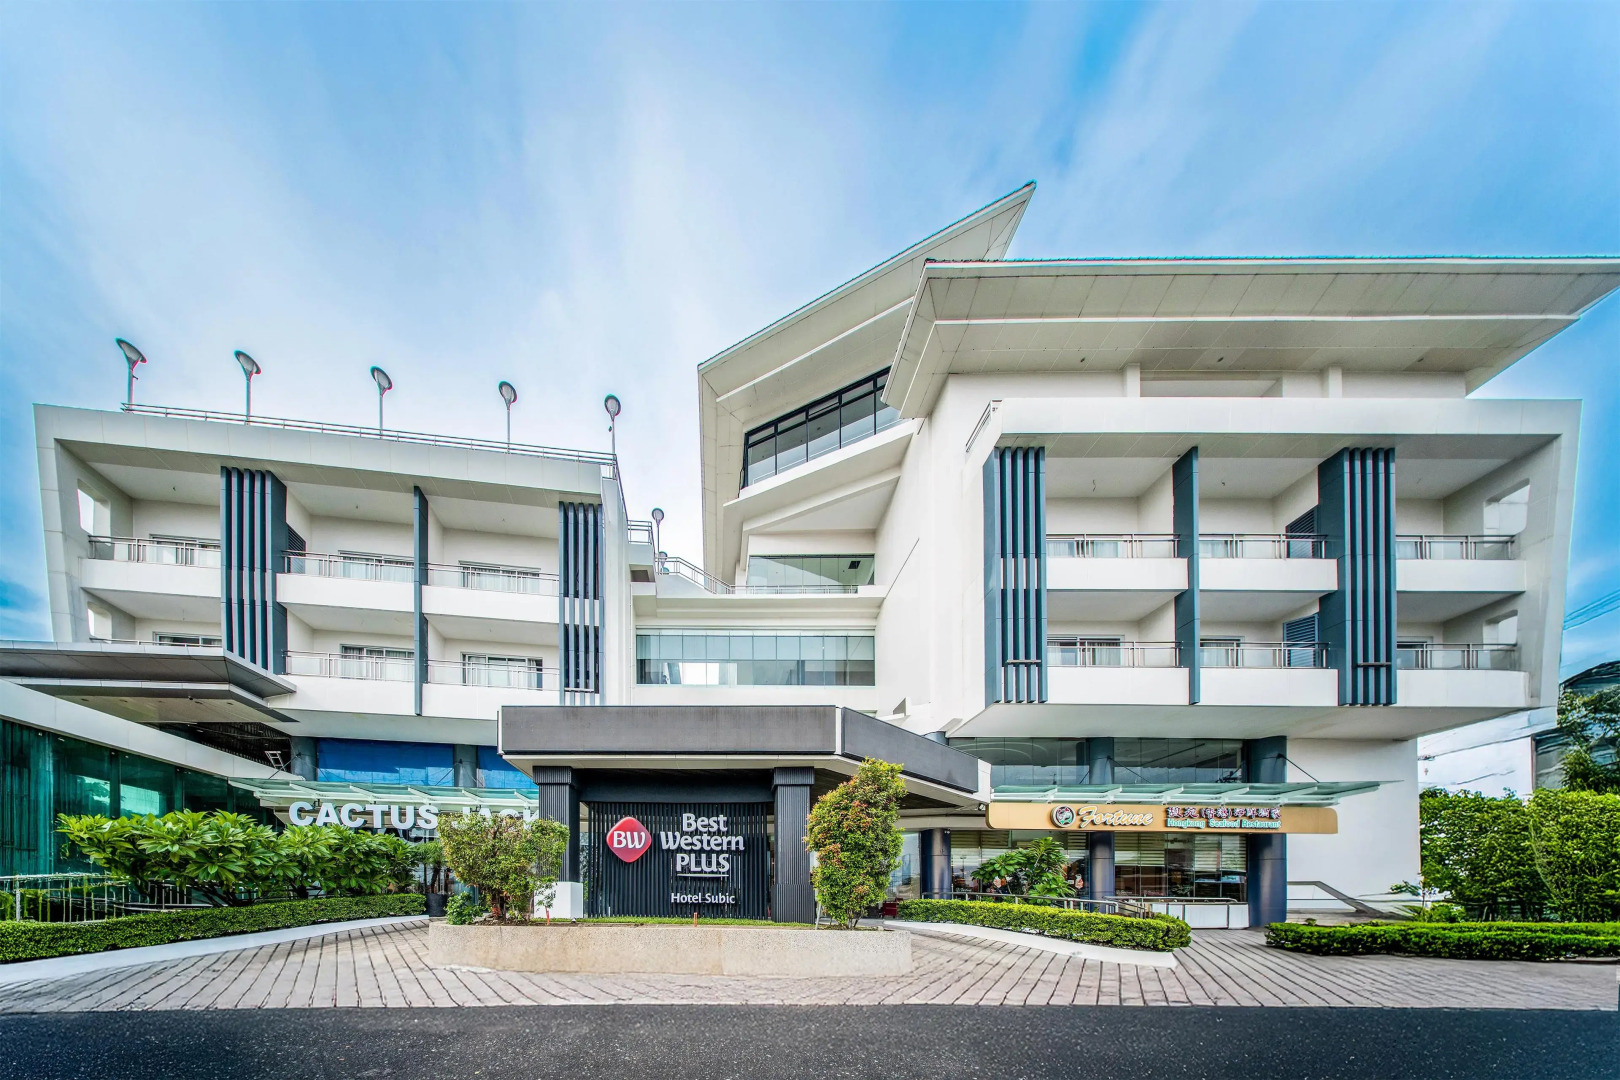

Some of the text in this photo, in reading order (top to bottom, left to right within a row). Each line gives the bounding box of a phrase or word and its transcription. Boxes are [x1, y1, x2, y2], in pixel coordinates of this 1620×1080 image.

[288, 801, 440, 831] CACTUS
[682, 813, 728, 832] Best
[1078, 805, 1153, 828] Fortune
[1167, 818, 1281, 829] Hongkong Seafood Restaurant
[613, 830, 646, 849] BW
[660, 831, 745, 851] Western
[676, 853, 730, 872] PLUS
[671, 892, 736, 904] Hotel Subic
